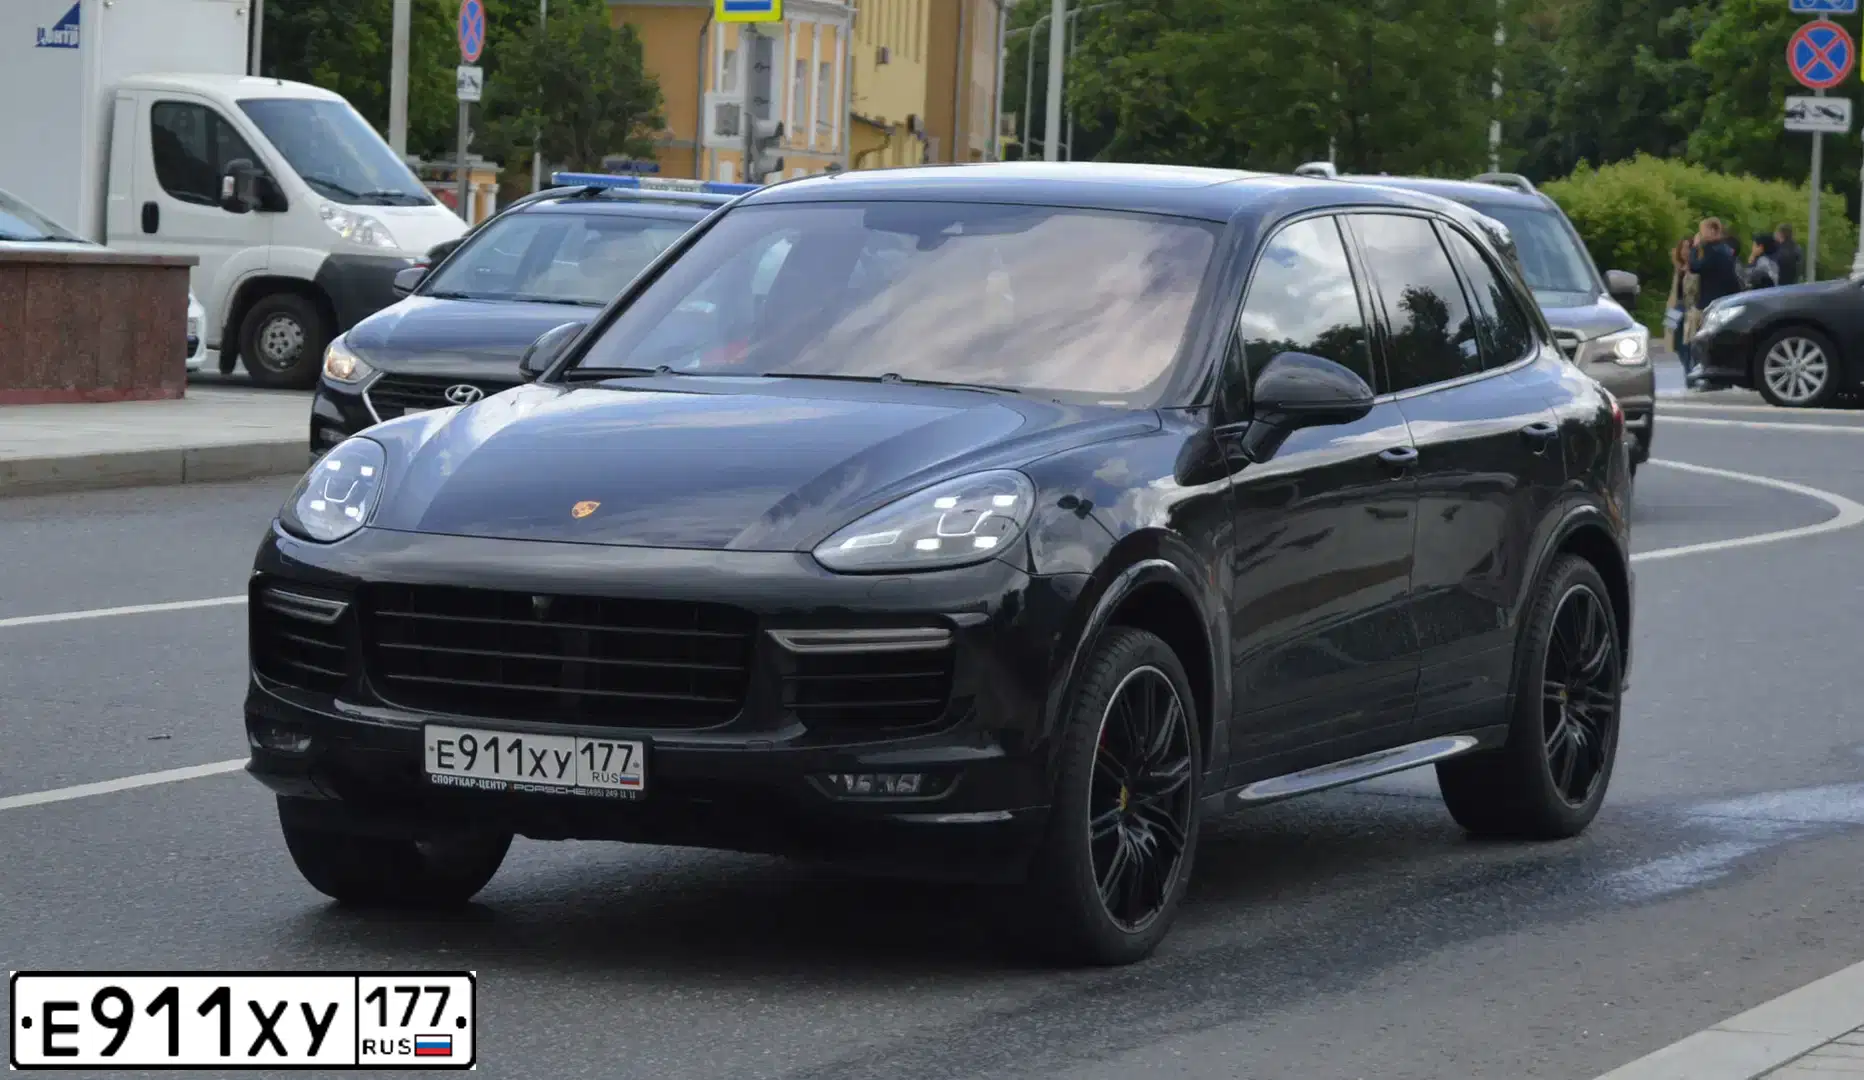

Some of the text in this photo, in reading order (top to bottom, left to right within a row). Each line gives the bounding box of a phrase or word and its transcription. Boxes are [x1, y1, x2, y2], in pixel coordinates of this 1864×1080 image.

[437, 733, 633, 779] Е911ХУ 177
[431, 774, 507, 790] СПОРТКАР-ЦЕНТР
[592, 771, 619, 783] RUS
[513, 783, 586, 796] PORSCHE
